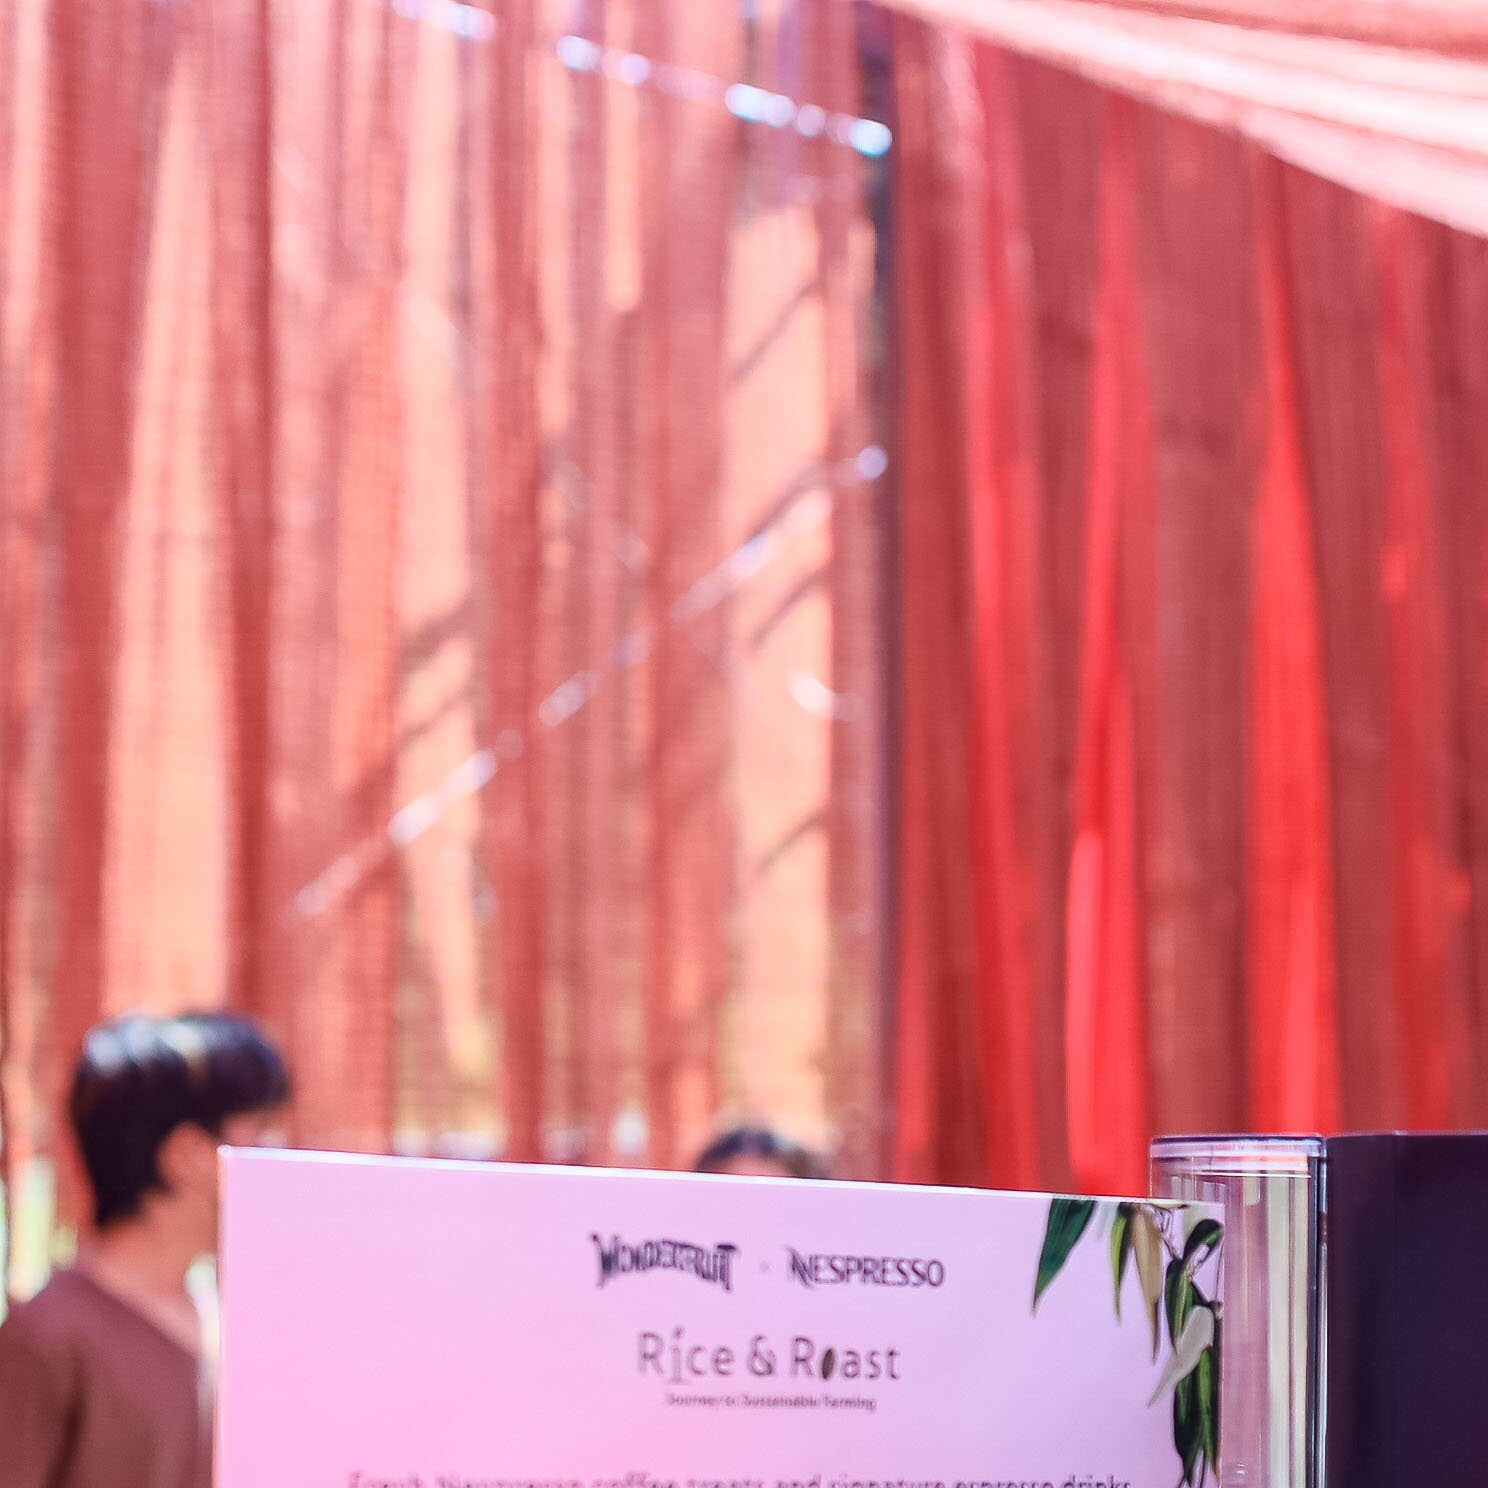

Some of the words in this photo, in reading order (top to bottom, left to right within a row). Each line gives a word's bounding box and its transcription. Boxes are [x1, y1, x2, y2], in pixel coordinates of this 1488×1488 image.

[786, 1248, 944, 1287] NESPRESSO
[638, 1327, 734, 1382] Rice
[749, 1335, 776, 1376] &
[792, 1336, 901, 1380] Roast
